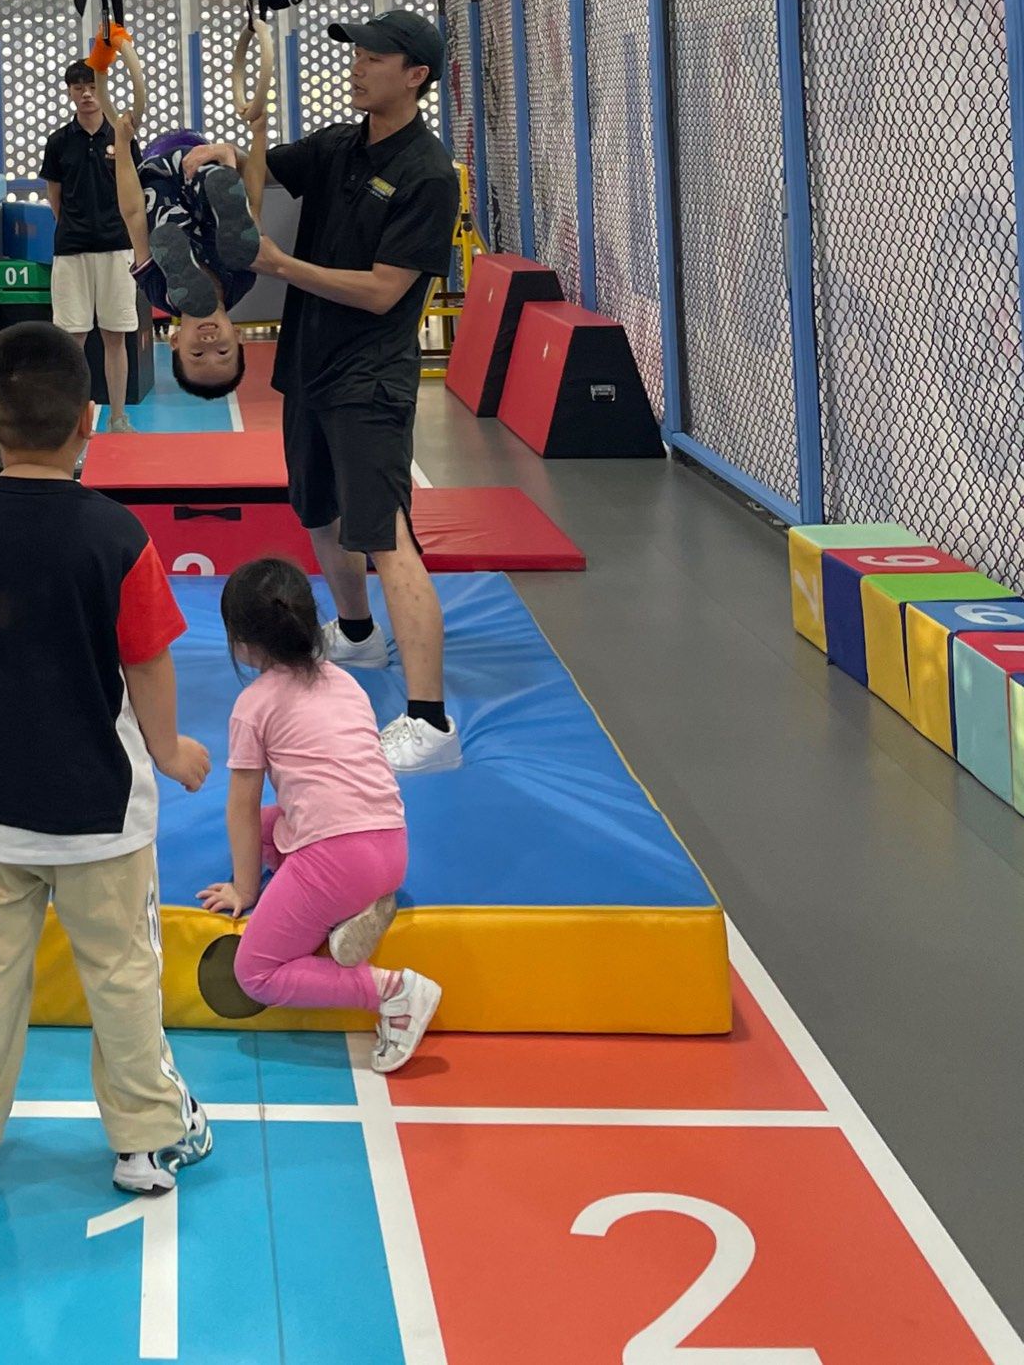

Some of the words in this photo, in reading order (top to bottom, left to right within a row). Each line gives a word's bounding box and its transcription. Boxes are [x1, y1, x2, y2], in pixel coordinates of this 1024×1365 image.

[5, 266, 29, 286] 01
[86, 1185, 178, 1358] 1
[570, 1191, 824, 1365] 2
